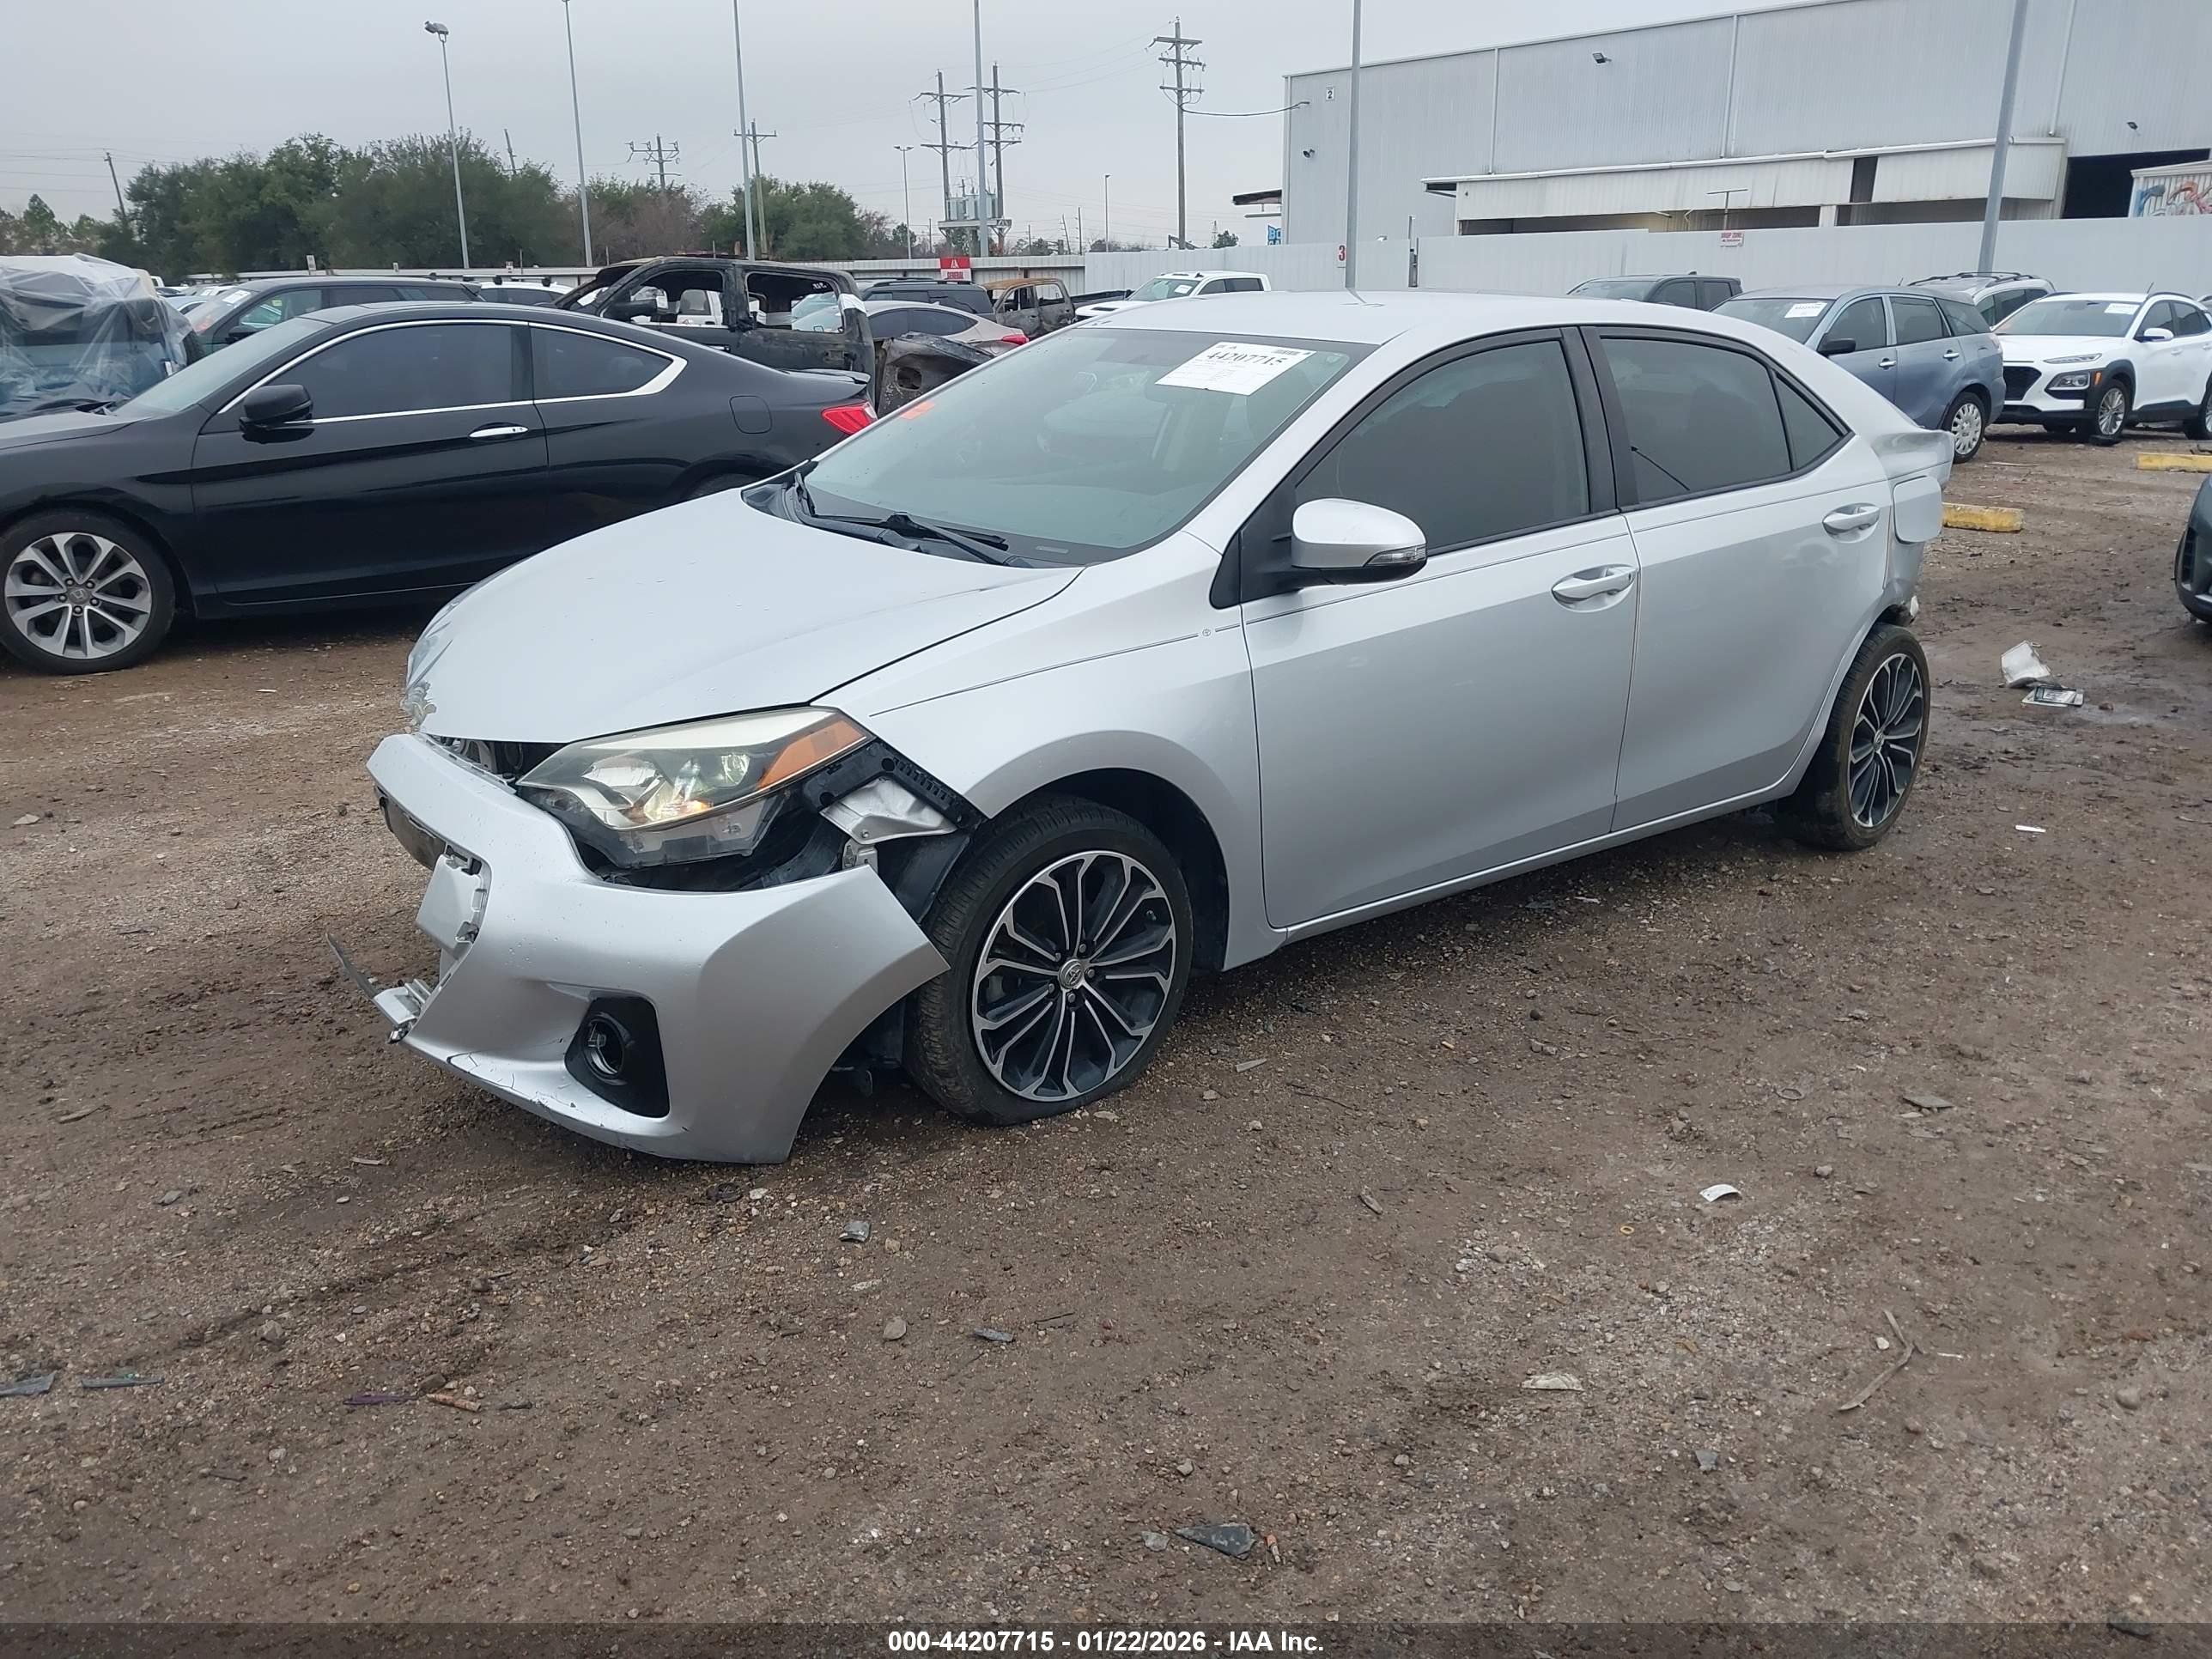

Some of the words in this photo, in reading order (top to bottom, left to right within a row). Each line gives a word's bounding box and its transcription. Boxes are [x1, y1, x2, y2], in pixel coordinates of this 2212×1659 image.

[1328, 90, 1333, 99] 2
[1339, 245, 1346, 261] 3
[1207, 351, 1287, 366] 44207715
